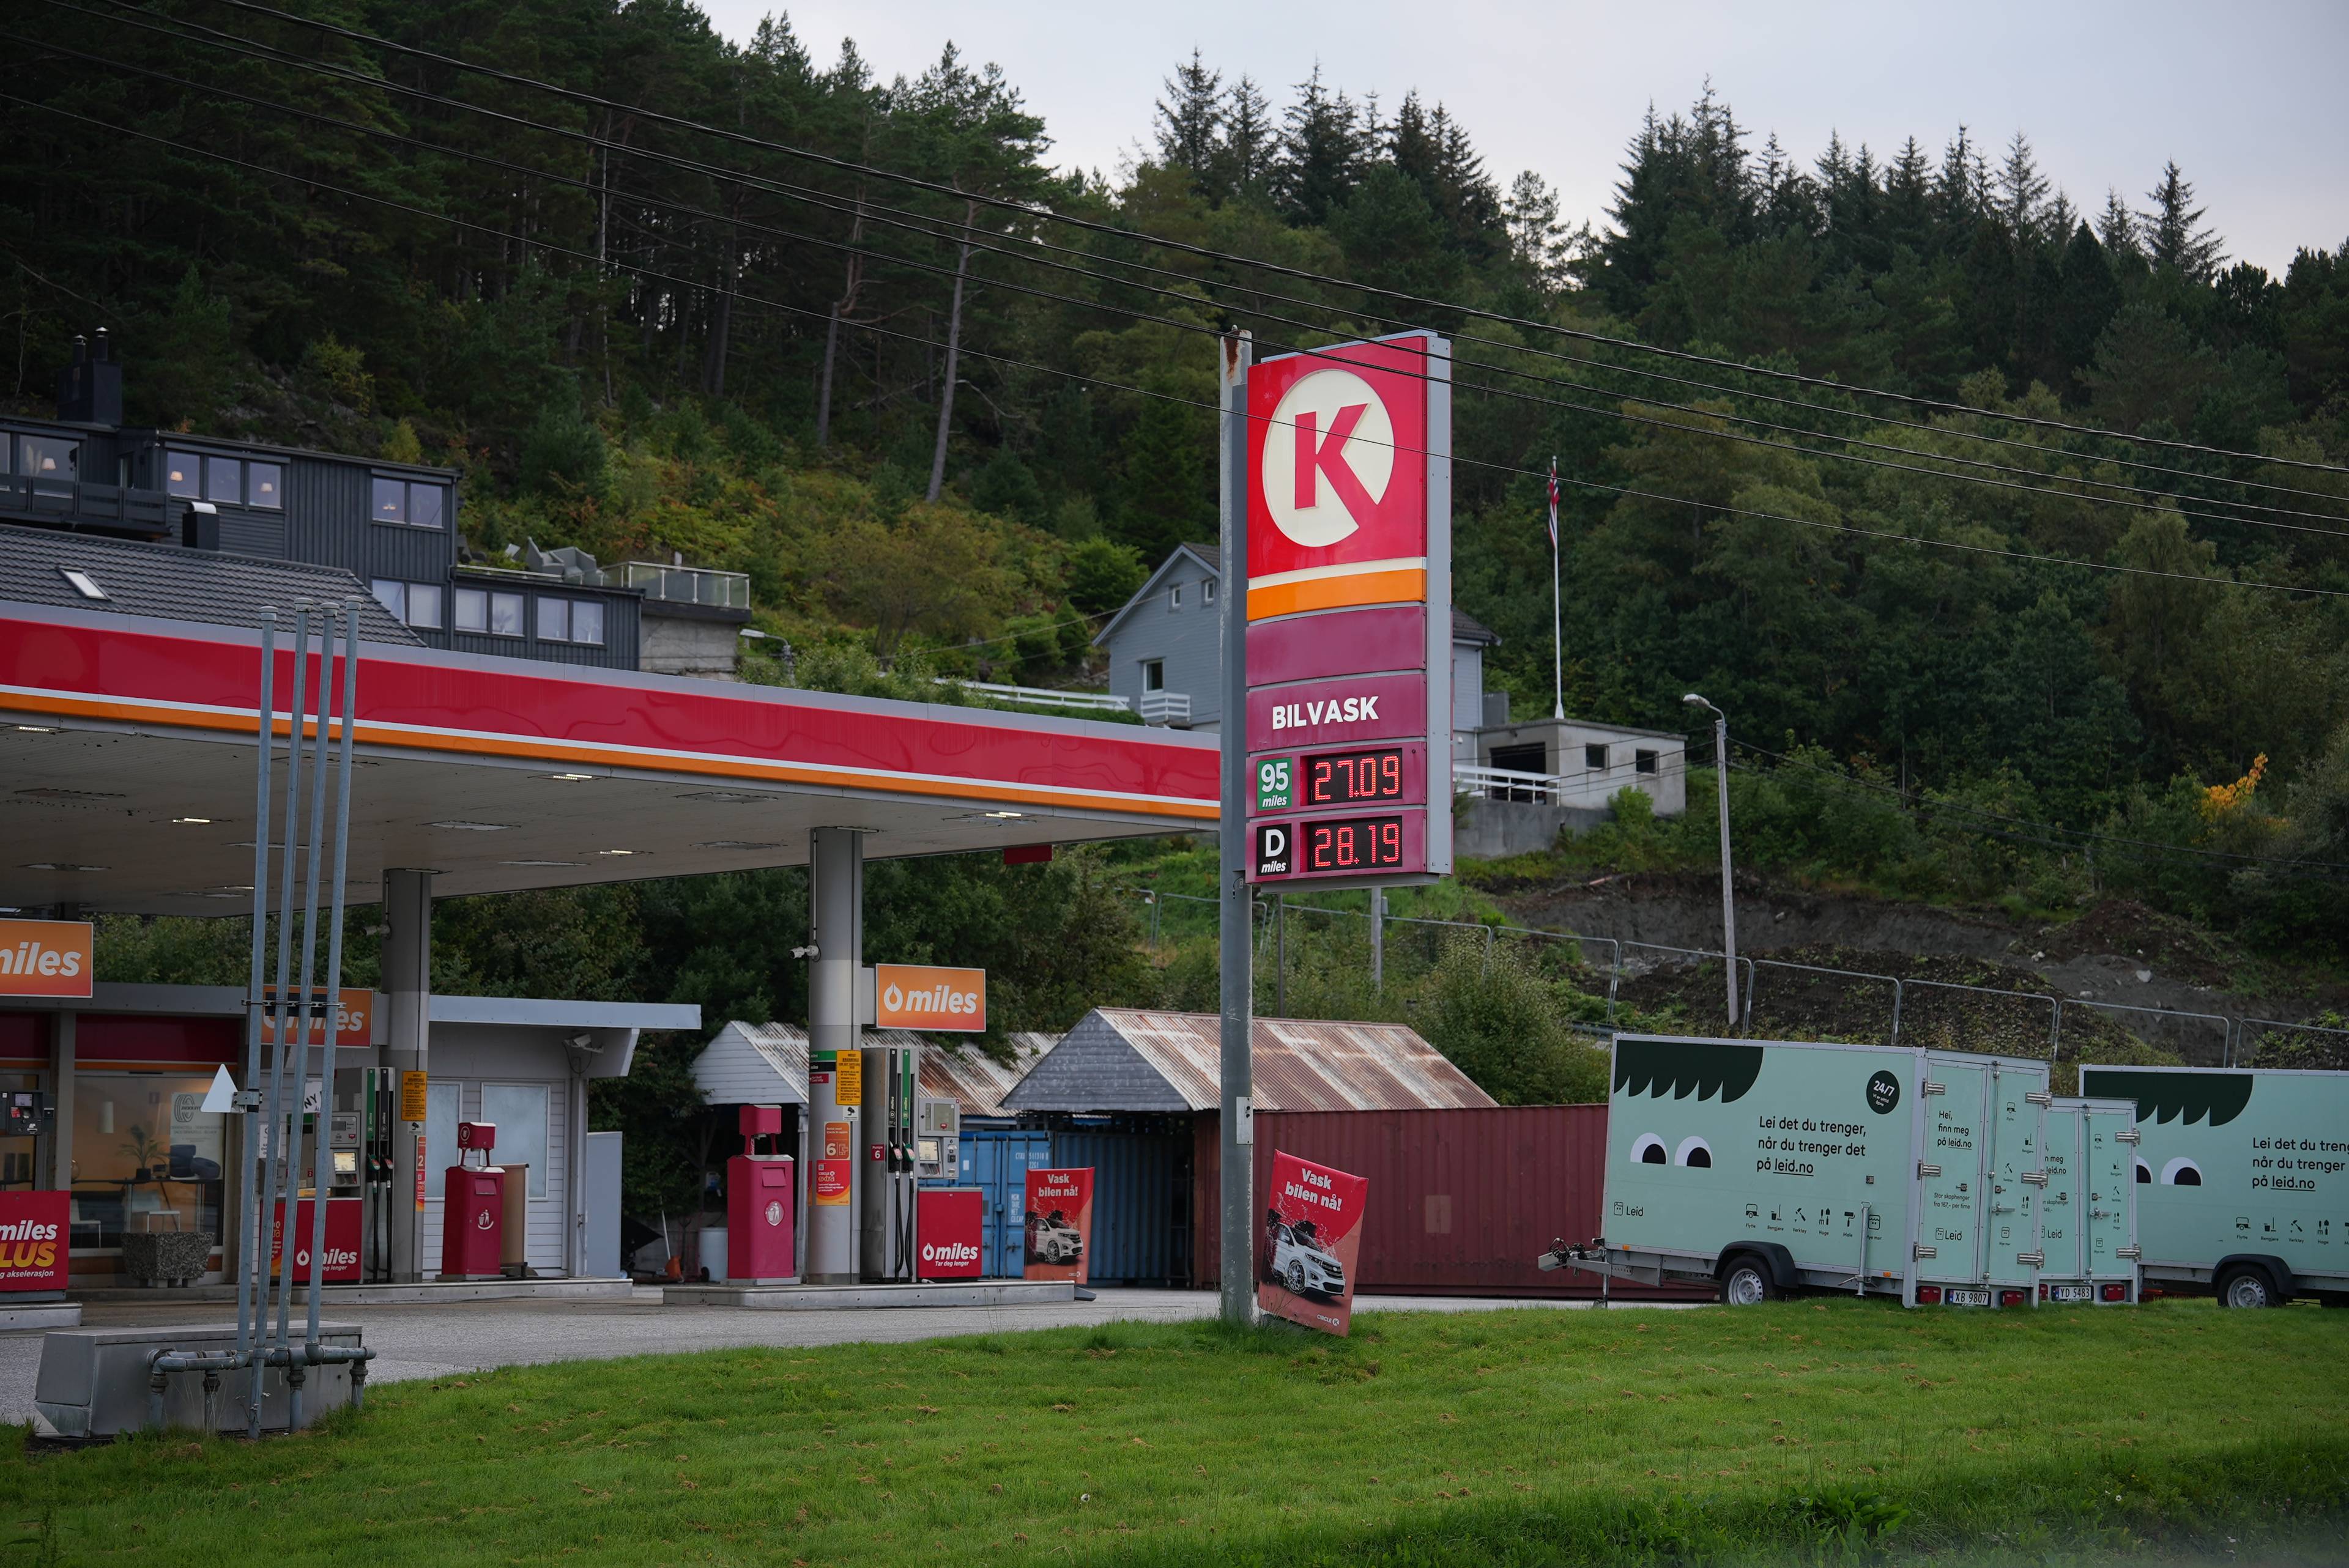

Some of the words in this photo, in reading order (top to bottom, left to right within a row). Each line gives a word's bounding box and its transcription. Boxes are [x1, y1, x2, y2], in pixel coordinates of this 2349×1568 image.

[1272, 696, 1379, 730] BILVASK
[1261, 762, 1289, 793] 95
[1315, 755, 1400, 801] 27.09
[1262, 795, 1288, 808] miles
[1265, 829, 1285, 857] D
[1315, 823, 1400, 867] 28.19
[1261, 861, 1286, 874] miles
[905, 985, 978, 1014] miles
[1873, 1080, 1895, 1096] 24/7
[1939, 1111, 1953, 1121] Hei,
[1759, 1115, 1776, 1128] Lei
[1779, 1117, 1798, 1130] det
[1802, 1119, 1816, 1131] du
[1820, 1120, 1866, 1137] trenger,
[1938, 1123, 1952, 1133] finn
[1953, 1126, 1969, 1136] meg
[826, 1142, 836, 1156] 6
[1758, 1136, 1777, 1150] når
[1780, 1138, 1794, 1151] du
[1798, 1139, 1842, 1157] trenger
[1846, 1142, 1866, 1156] det
[1937, 1137, 1946, 1147] på
[1948, 1137, 1972, 1148] leid.no
[2252, 1137, 2271, 1149] Lei
[2274, 1138, 2296, 1150] det
[2300, 1139, 2315, 1151] du
[2320, 1141, 2349, 1155] tren
[418, 1155, 423, 1166] 2
[1757, 1157, 1772, 1172] på
[1775, 1158, 1814, 1175] leid.no
[2050, 1156, 2063, 1164] meg
[2252, 1155, 2273, 1168] når
[2277, 1156, 2293, 1169] du
[2297, 1159, 2345, 1174] trenger
[1047, 1174, 1070, 1184] Vask
[1301, 1168, 1332, 1190] Vask
[2252, 1175, 2268, 1189] på
[2272, 1175, 2315, 1190] leid.no
[1038, 1186, 1061, 1197] bilen
[1063, 1185, 1078, 1196] nå!
[1285, 1182, 1318, 1204] bilen
[1321, 1194, 1343, 1211] nå!
[1626, 1205, 1644, 1216] Leid
[0, 1220, 58, 1240] miles
[1945, 1230, 1962, 1241] Leid
[2047, 1229, 2062, 1238] Leid
[0, 1242, 58, 1268] LUS
[935, 1243, 978, 1260] miles
[6, 1270, 54, 1278] akselerasjon
[1955, 1292, 1965, 1302] XB
[1969, 1293, 1987, 1303] 9807
[2060, 1287, 2070, 1298] YD
[2073, 1288, 2090, 1298] 5483
[1316, 1314, 1332, 1324] CIRCLE
